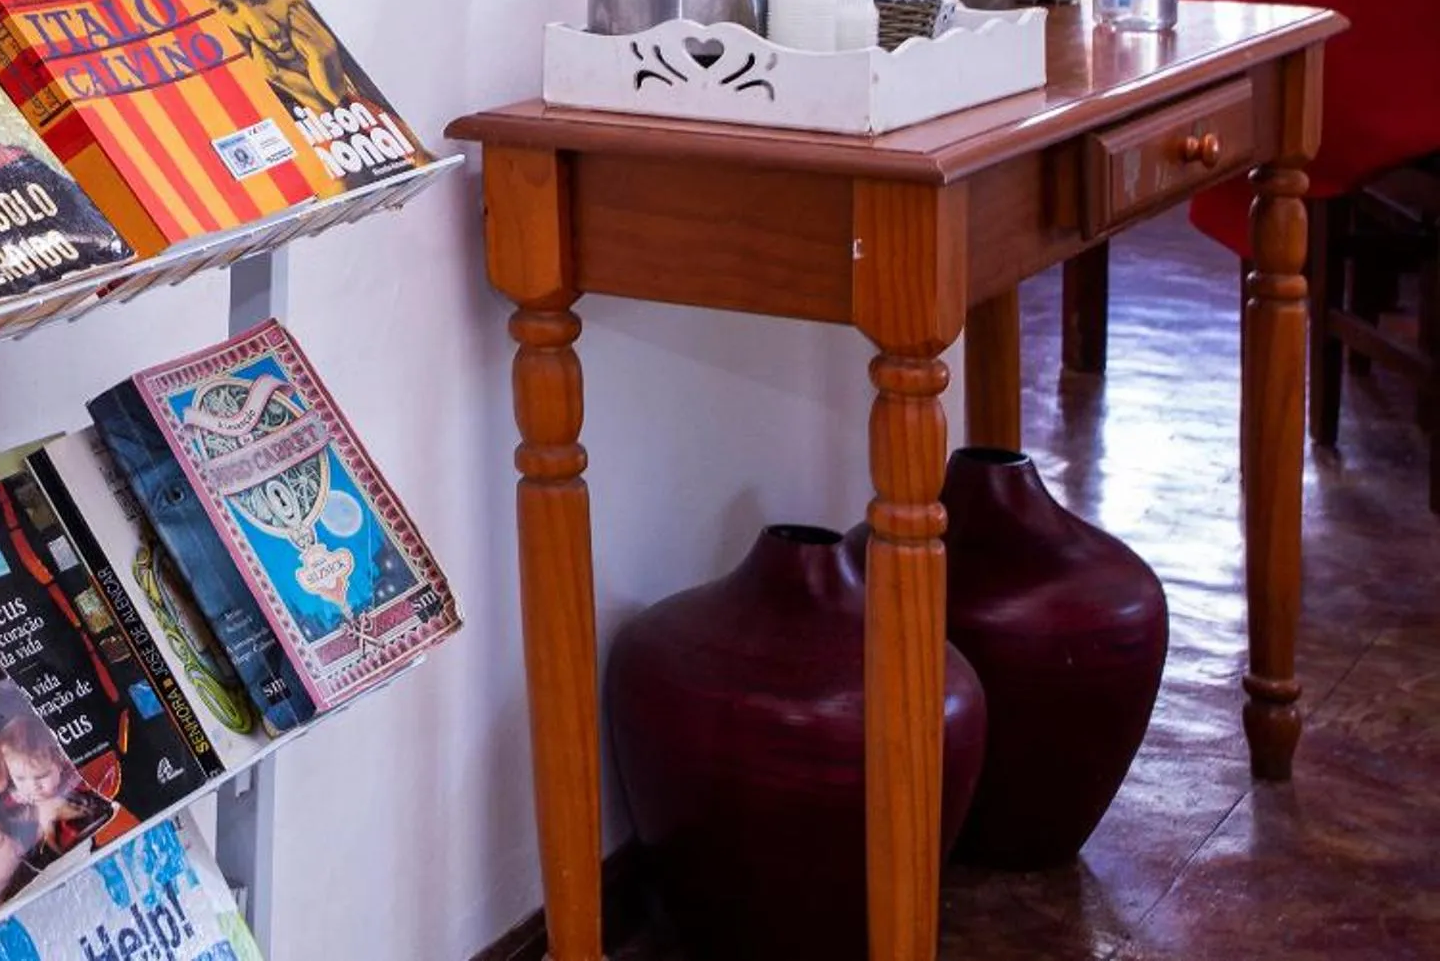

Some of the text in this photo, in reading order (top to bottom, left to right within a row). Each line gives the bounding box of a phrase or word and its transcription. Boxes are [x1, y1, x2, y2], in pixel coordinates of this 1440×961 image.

[64, 30, 225, 99] CALVINO
[293, 102, 378, 144] ilson
[314, 112, 416, 181] onal
[96, 565, 140, 629] ALENCAR
[17, 639, 45, 659] vida
[31, 671, 62, 695] vida
[76, 678, 94, 698] de
[57, 713, 94, 746] eus
[165, 686, 210, 756] SENHORA
[79, 881, 196, 961] Help!
